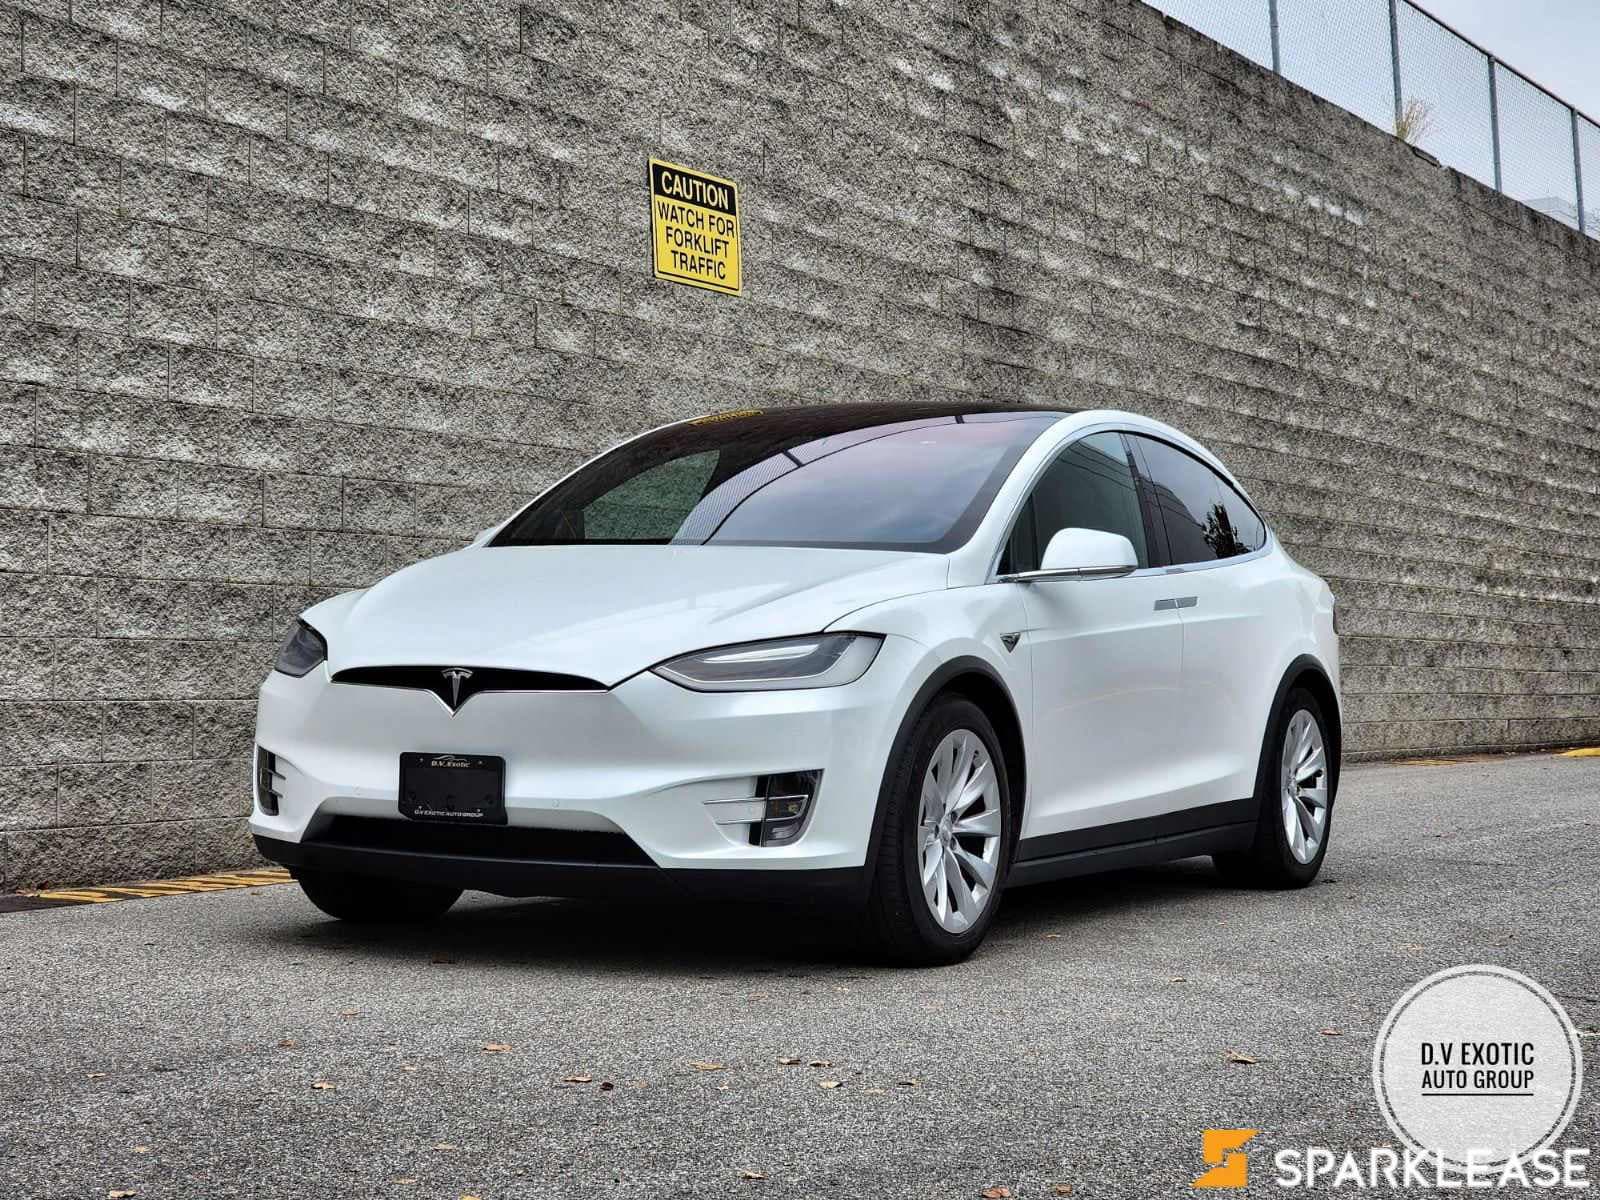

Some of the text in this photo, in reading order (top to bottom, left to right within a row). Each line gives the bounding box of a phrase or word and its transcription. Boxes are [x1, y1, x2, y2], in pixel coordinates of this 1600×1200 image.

[661, 171, 729, 210] CAUTION
[657, 200, 735, 238] WATCH FOR
[665, 226, 729, 258] FORKLIFT
[671, 250, 726, 279] TRAFFIC
